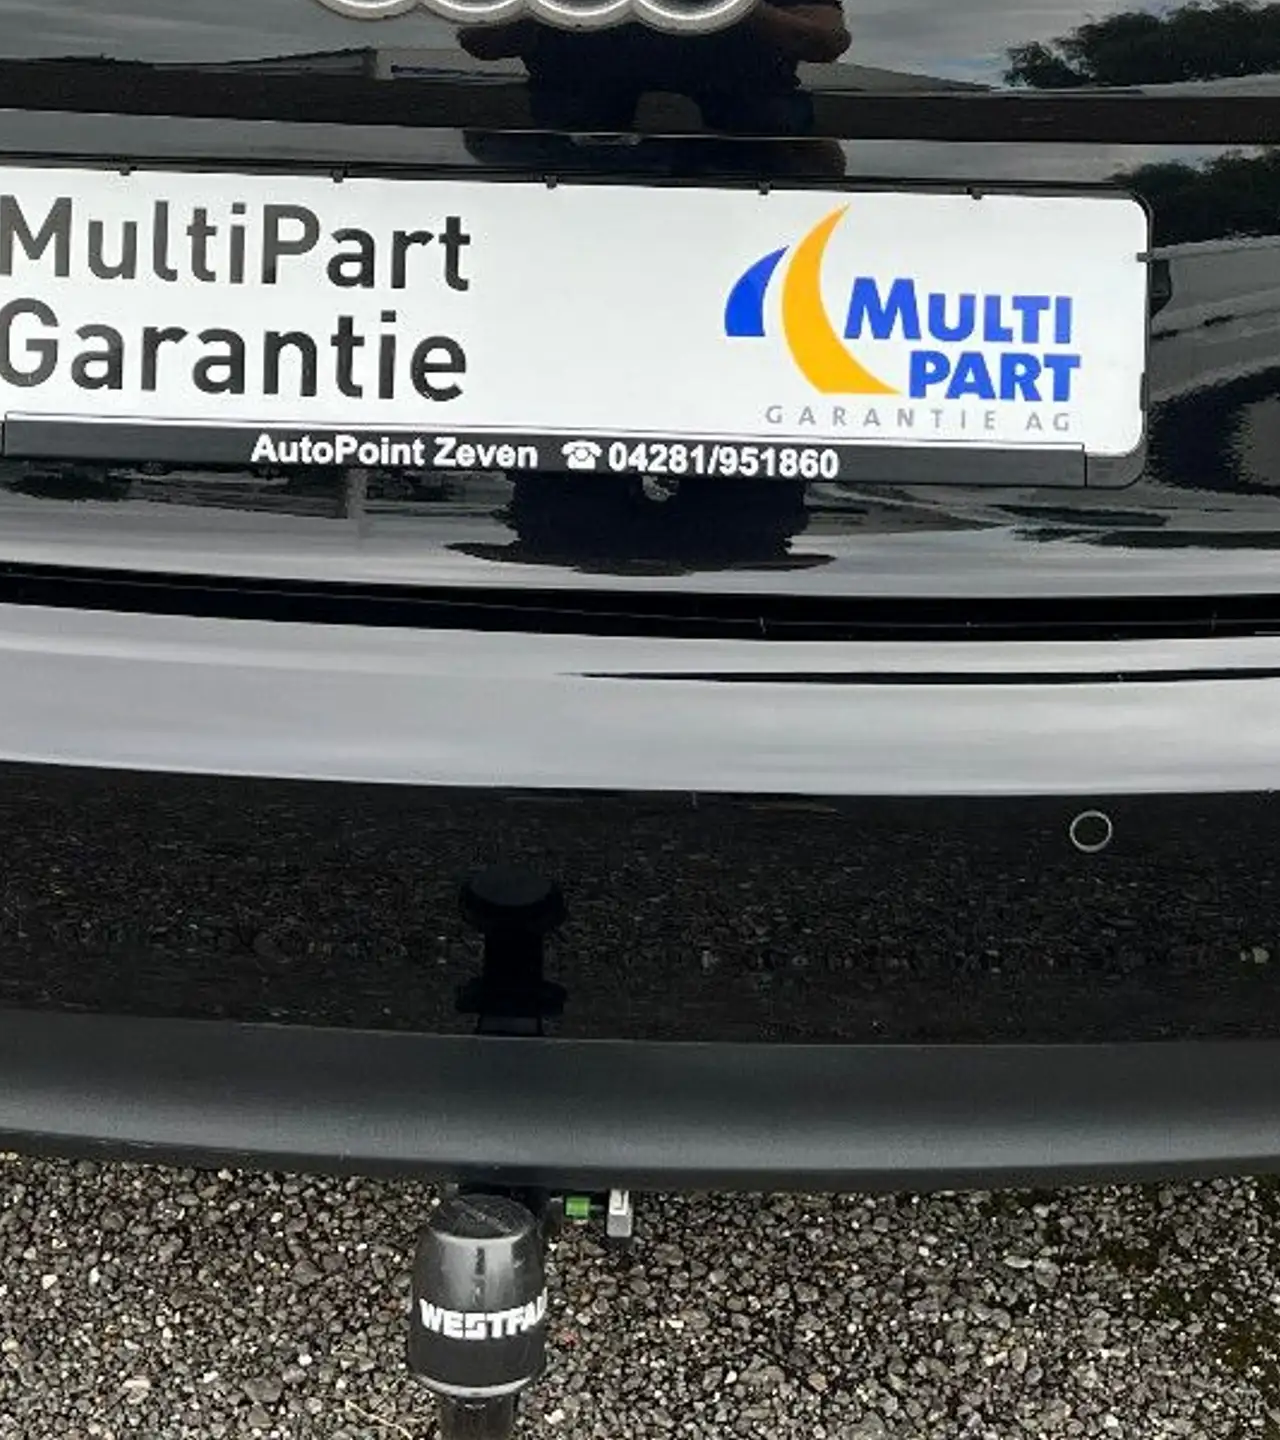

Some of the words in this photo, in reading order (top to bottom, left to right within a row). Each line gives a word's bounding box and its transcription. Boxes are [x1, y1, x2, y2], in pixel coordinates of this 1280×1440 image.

[843, 276, 1073, 345] MULTI
[908, 350, 1081, 403] PART
[765, 404, 996, 430] GARANTIE
[1025, 411, 1070, 432] AG
[250, 433, 425, 467] AutoPoint
[433, 437, 539, 469] Zeven
[608, 441, 840, 480] 04281/951860
